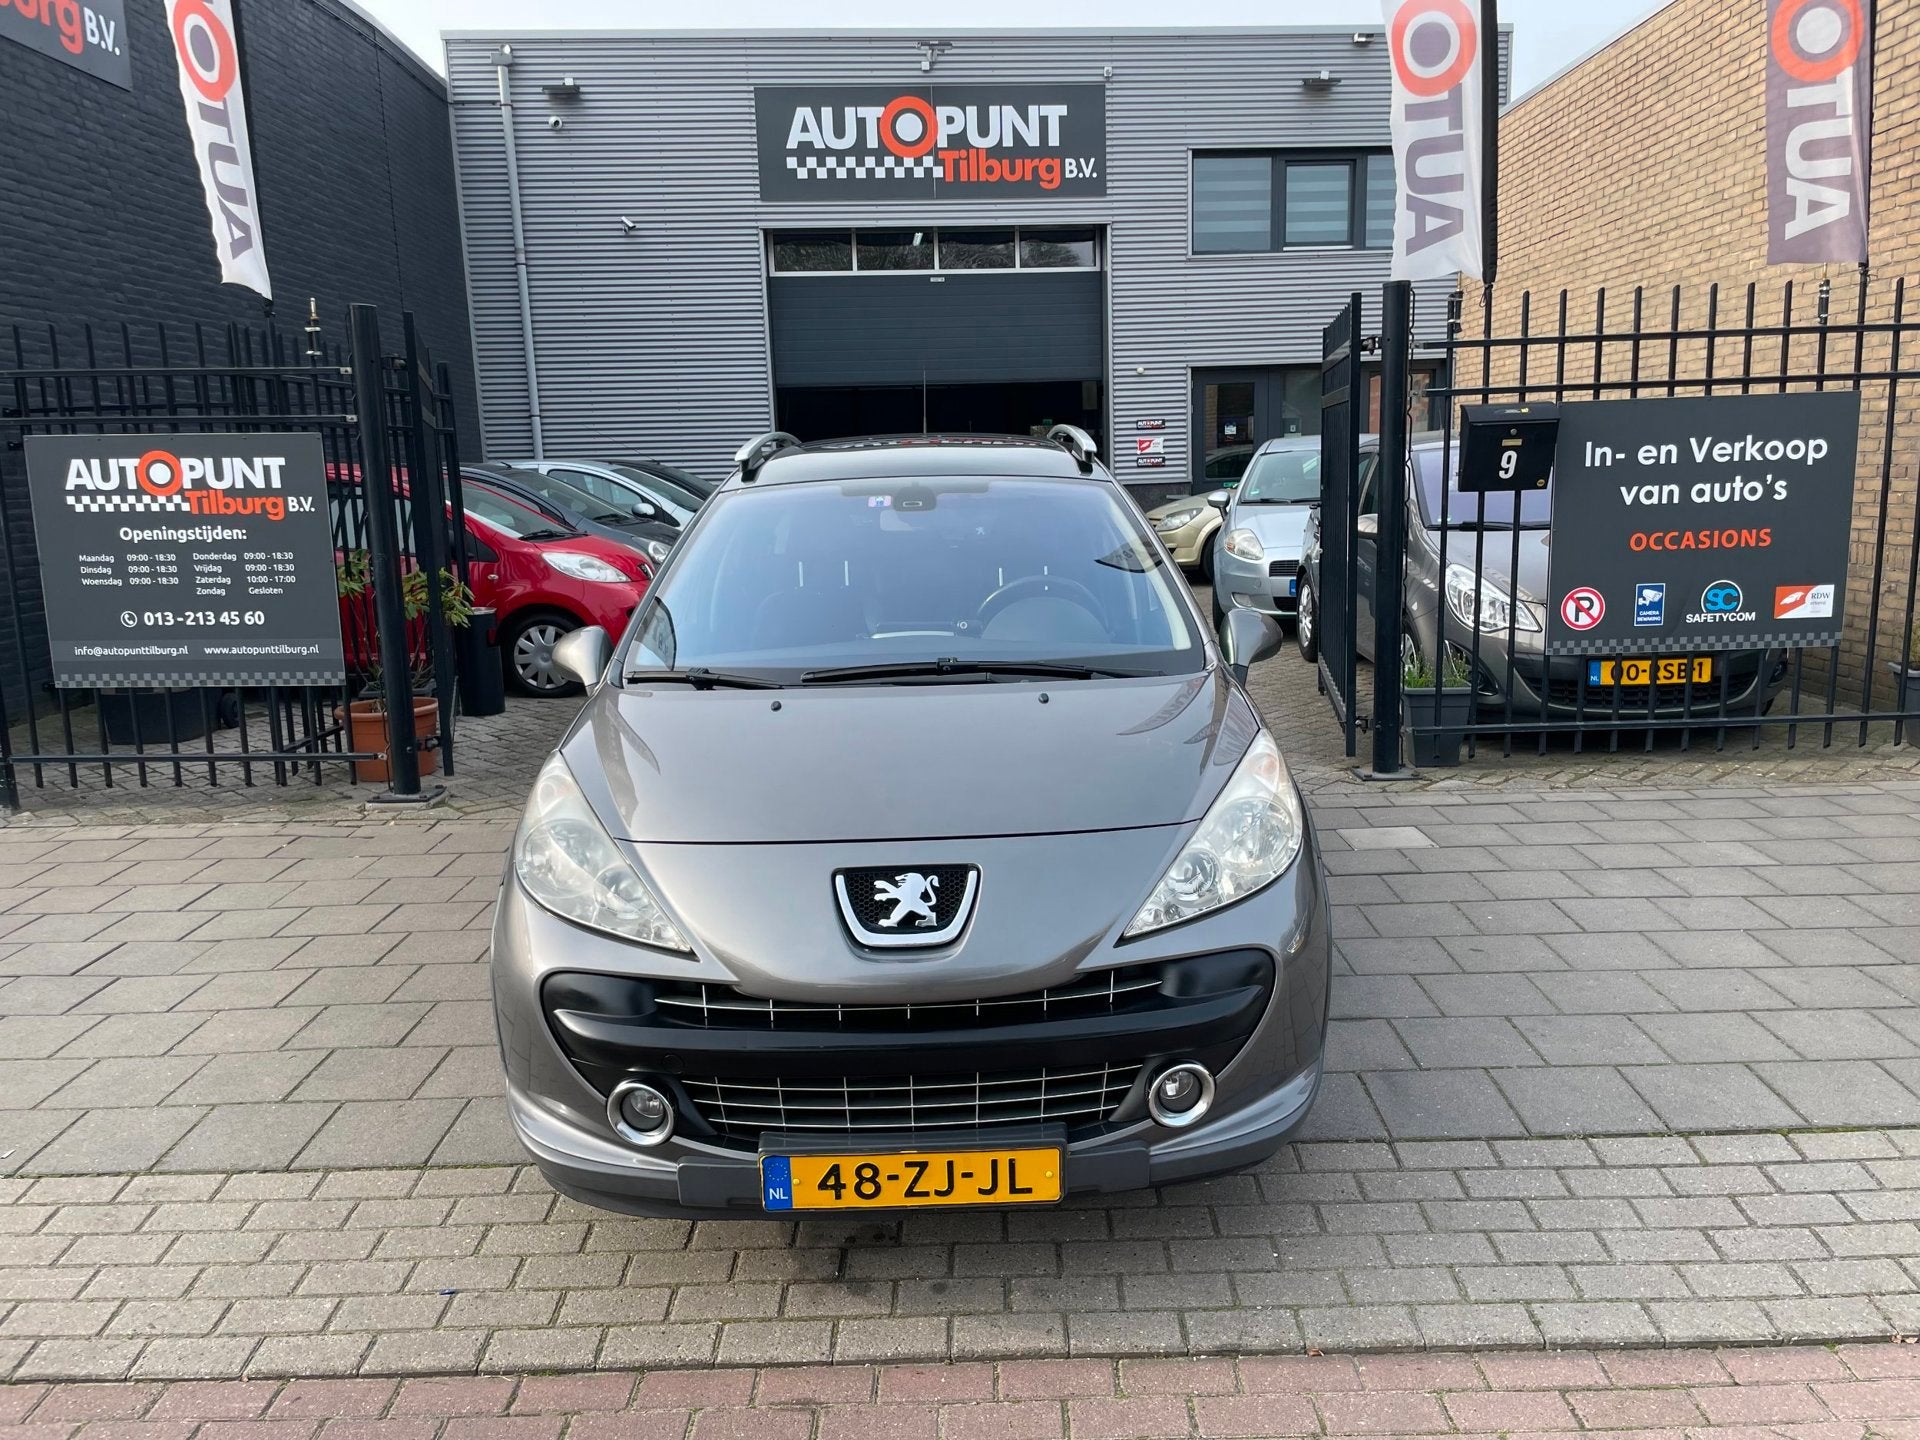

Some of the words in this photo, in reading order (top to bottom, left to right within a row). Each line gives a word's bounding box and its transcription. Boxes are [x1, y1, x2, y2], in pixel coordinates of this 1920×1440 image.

[83, 7, 121, 56] B.V.
[786, 95, 1068, 159] AUTOPUNT
[938, 149, 1061, 190] Tilburg
[1065, 157, 1097, 178] B.V.
[1585, 441, 1625, 467] In-
[1637, 441, 1678, 465] en
[1690, 435, 1828, 465] Verkoop
[1499, 450, 1518, 479] 9
[65, 450, 286, 497] AUTOPUNT
[1620, 482, 1680, 506] van
[1691, 474, 1787, 504] auto's
[184, 489, 285, 521] Tilburg
[288, 496, 315, 512] B.V.
[119, 526, 248, 543] Openingstijden:
[1629, 528, 1772, 552] OCCASIONS
[79, 554, 115, 563] Maandag
[193, 552, 237, 561] Donderdag
[243, 552, 266, 560] 09:00
[272, 552, 294, 560] 18:30
[80, 566, 112, 575] Dinsdag
[128, 565, 150, 573] 09:00
[156, 565, 178, 573] 18:30
[193, 564, 222, 573] Vrijdag
[81, 577, 122, 586] Woensdag
[129, 577, 151, 585] 09:00
[157, 577, 179, 585] 18:30
[195, 576, 231, 585] Zaterdag
[196, 587, 226, 596] Zondag
[219, 611, 240, 625] 45
[245, 611, 265, 625] 60
[1685, 612, 1756, 623] SAFETYCOM
[74, 645, 188, 657] info@autopunttilburg.nl
[204, 644, 319, 656] www.autopunttilburg.nl
[818, 1158, 1033, 1201] 48-ZJ-JL
[769, 1187, 788, 1200] NL
